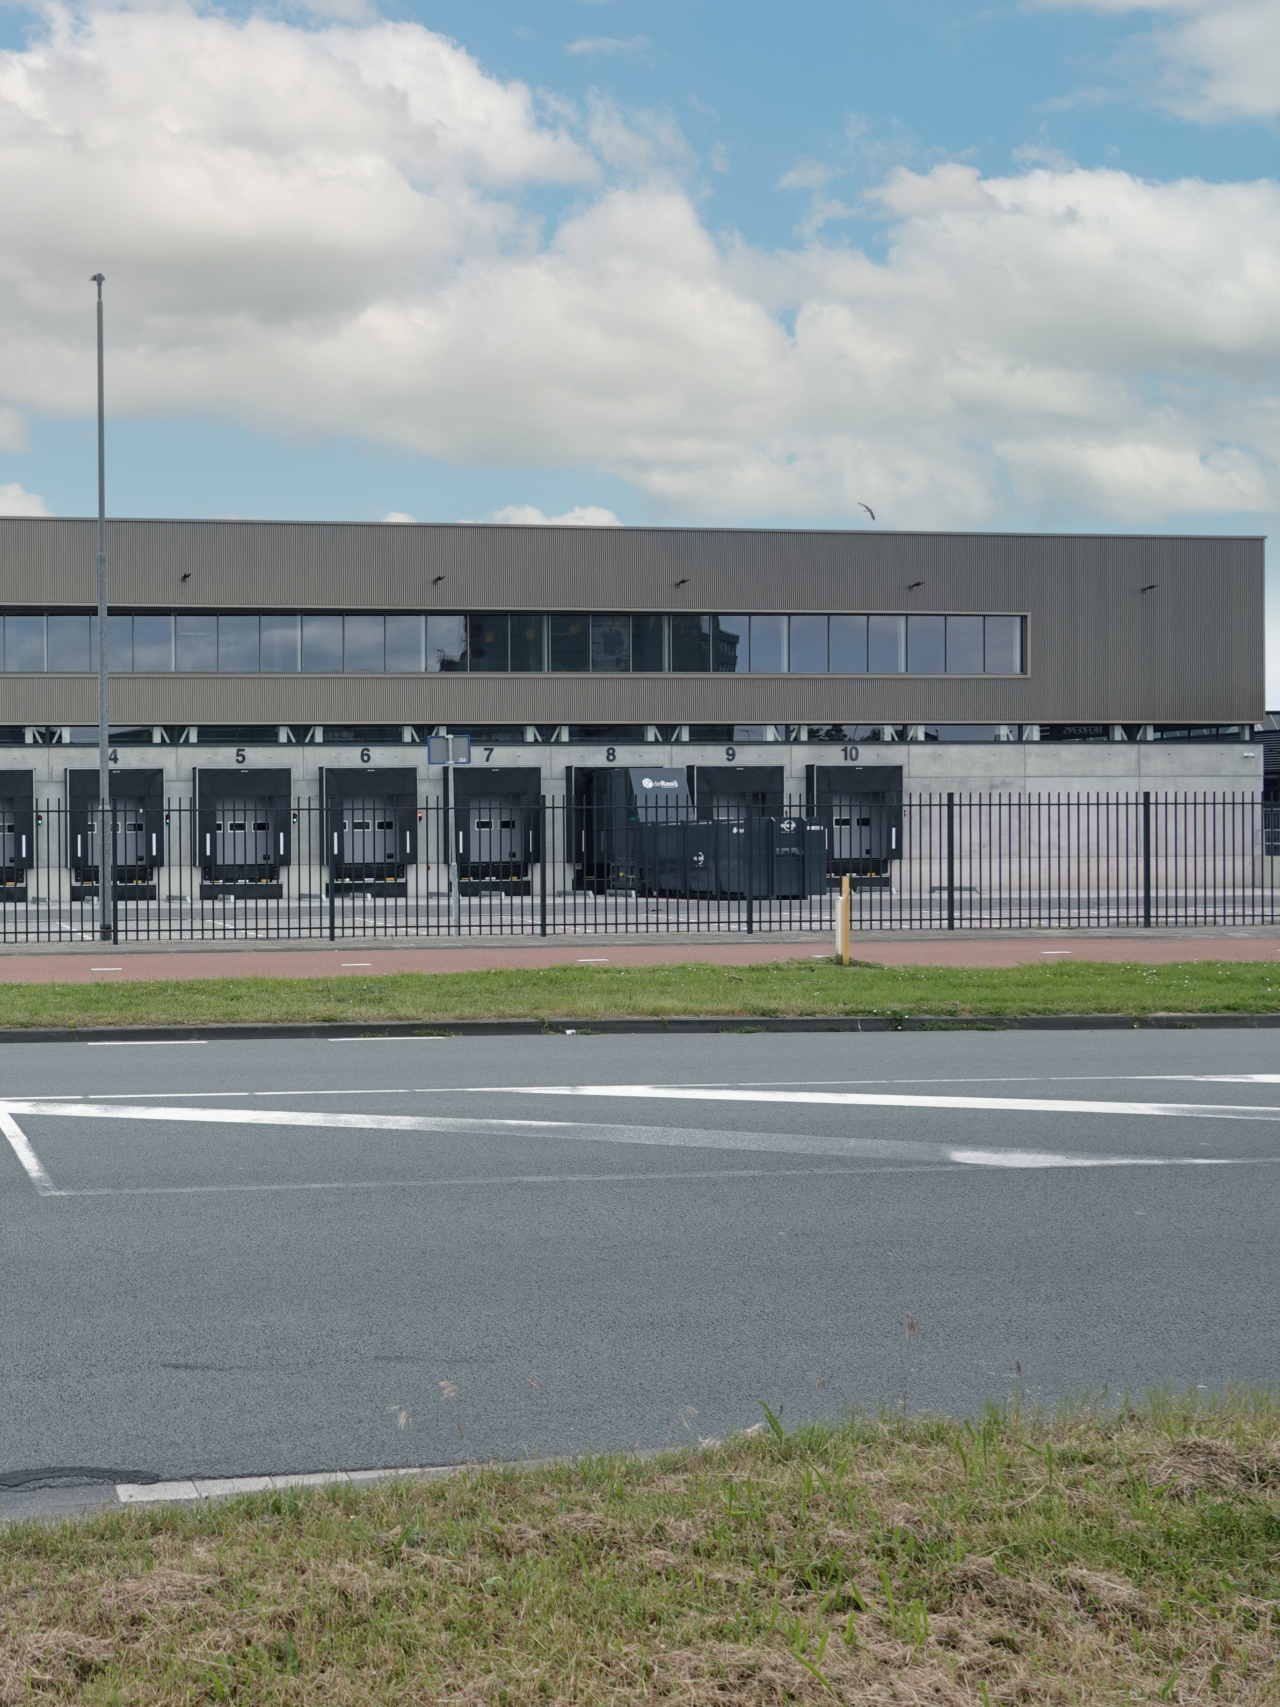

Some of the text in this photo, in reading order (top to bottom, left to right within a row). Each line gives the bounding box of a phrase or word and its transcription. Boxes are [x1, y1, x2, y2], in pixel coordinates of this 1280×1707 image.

[108, 748, 119, 764] 4
[235, 748, 246, 764] 5
[360, 747, 371, 763] 6
[483, 747, 494, 762] 7
[605, 746, 616, 762] 8
[725, 746, 736, 762] 9
[841, 746, 859, 761] 10
